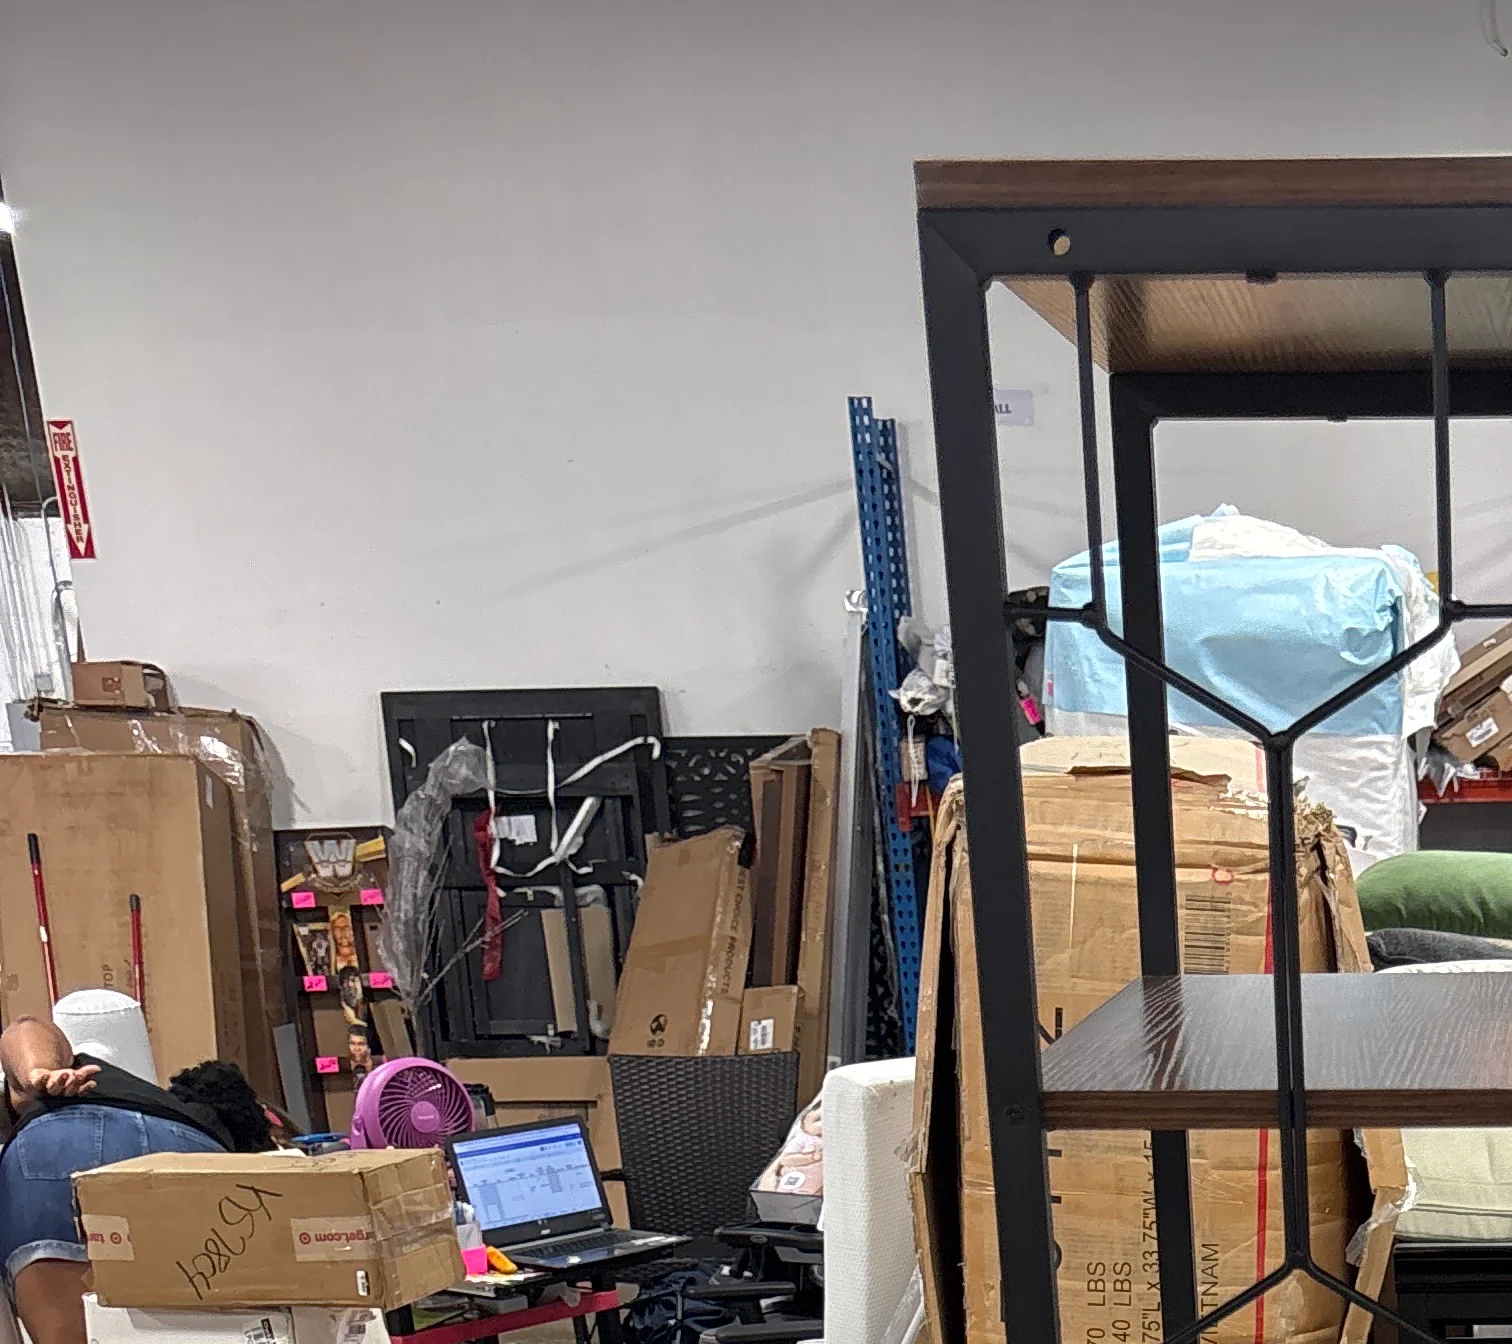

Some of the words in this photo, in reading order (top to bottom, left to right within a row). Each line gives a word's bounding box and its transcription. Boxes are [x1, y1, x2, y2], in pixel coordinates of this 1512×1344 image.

[53, 432, 74, 452] FIRE
[61, 454, 85, 544] EXTINGUISHER
[729, 892, 745, 936] CHOICE
[720, 935, 739, 995] PRODUCTS
[1086, 1261, 1107, 1307] LBS
[1112, 1261, 1132, 1307] LBS
